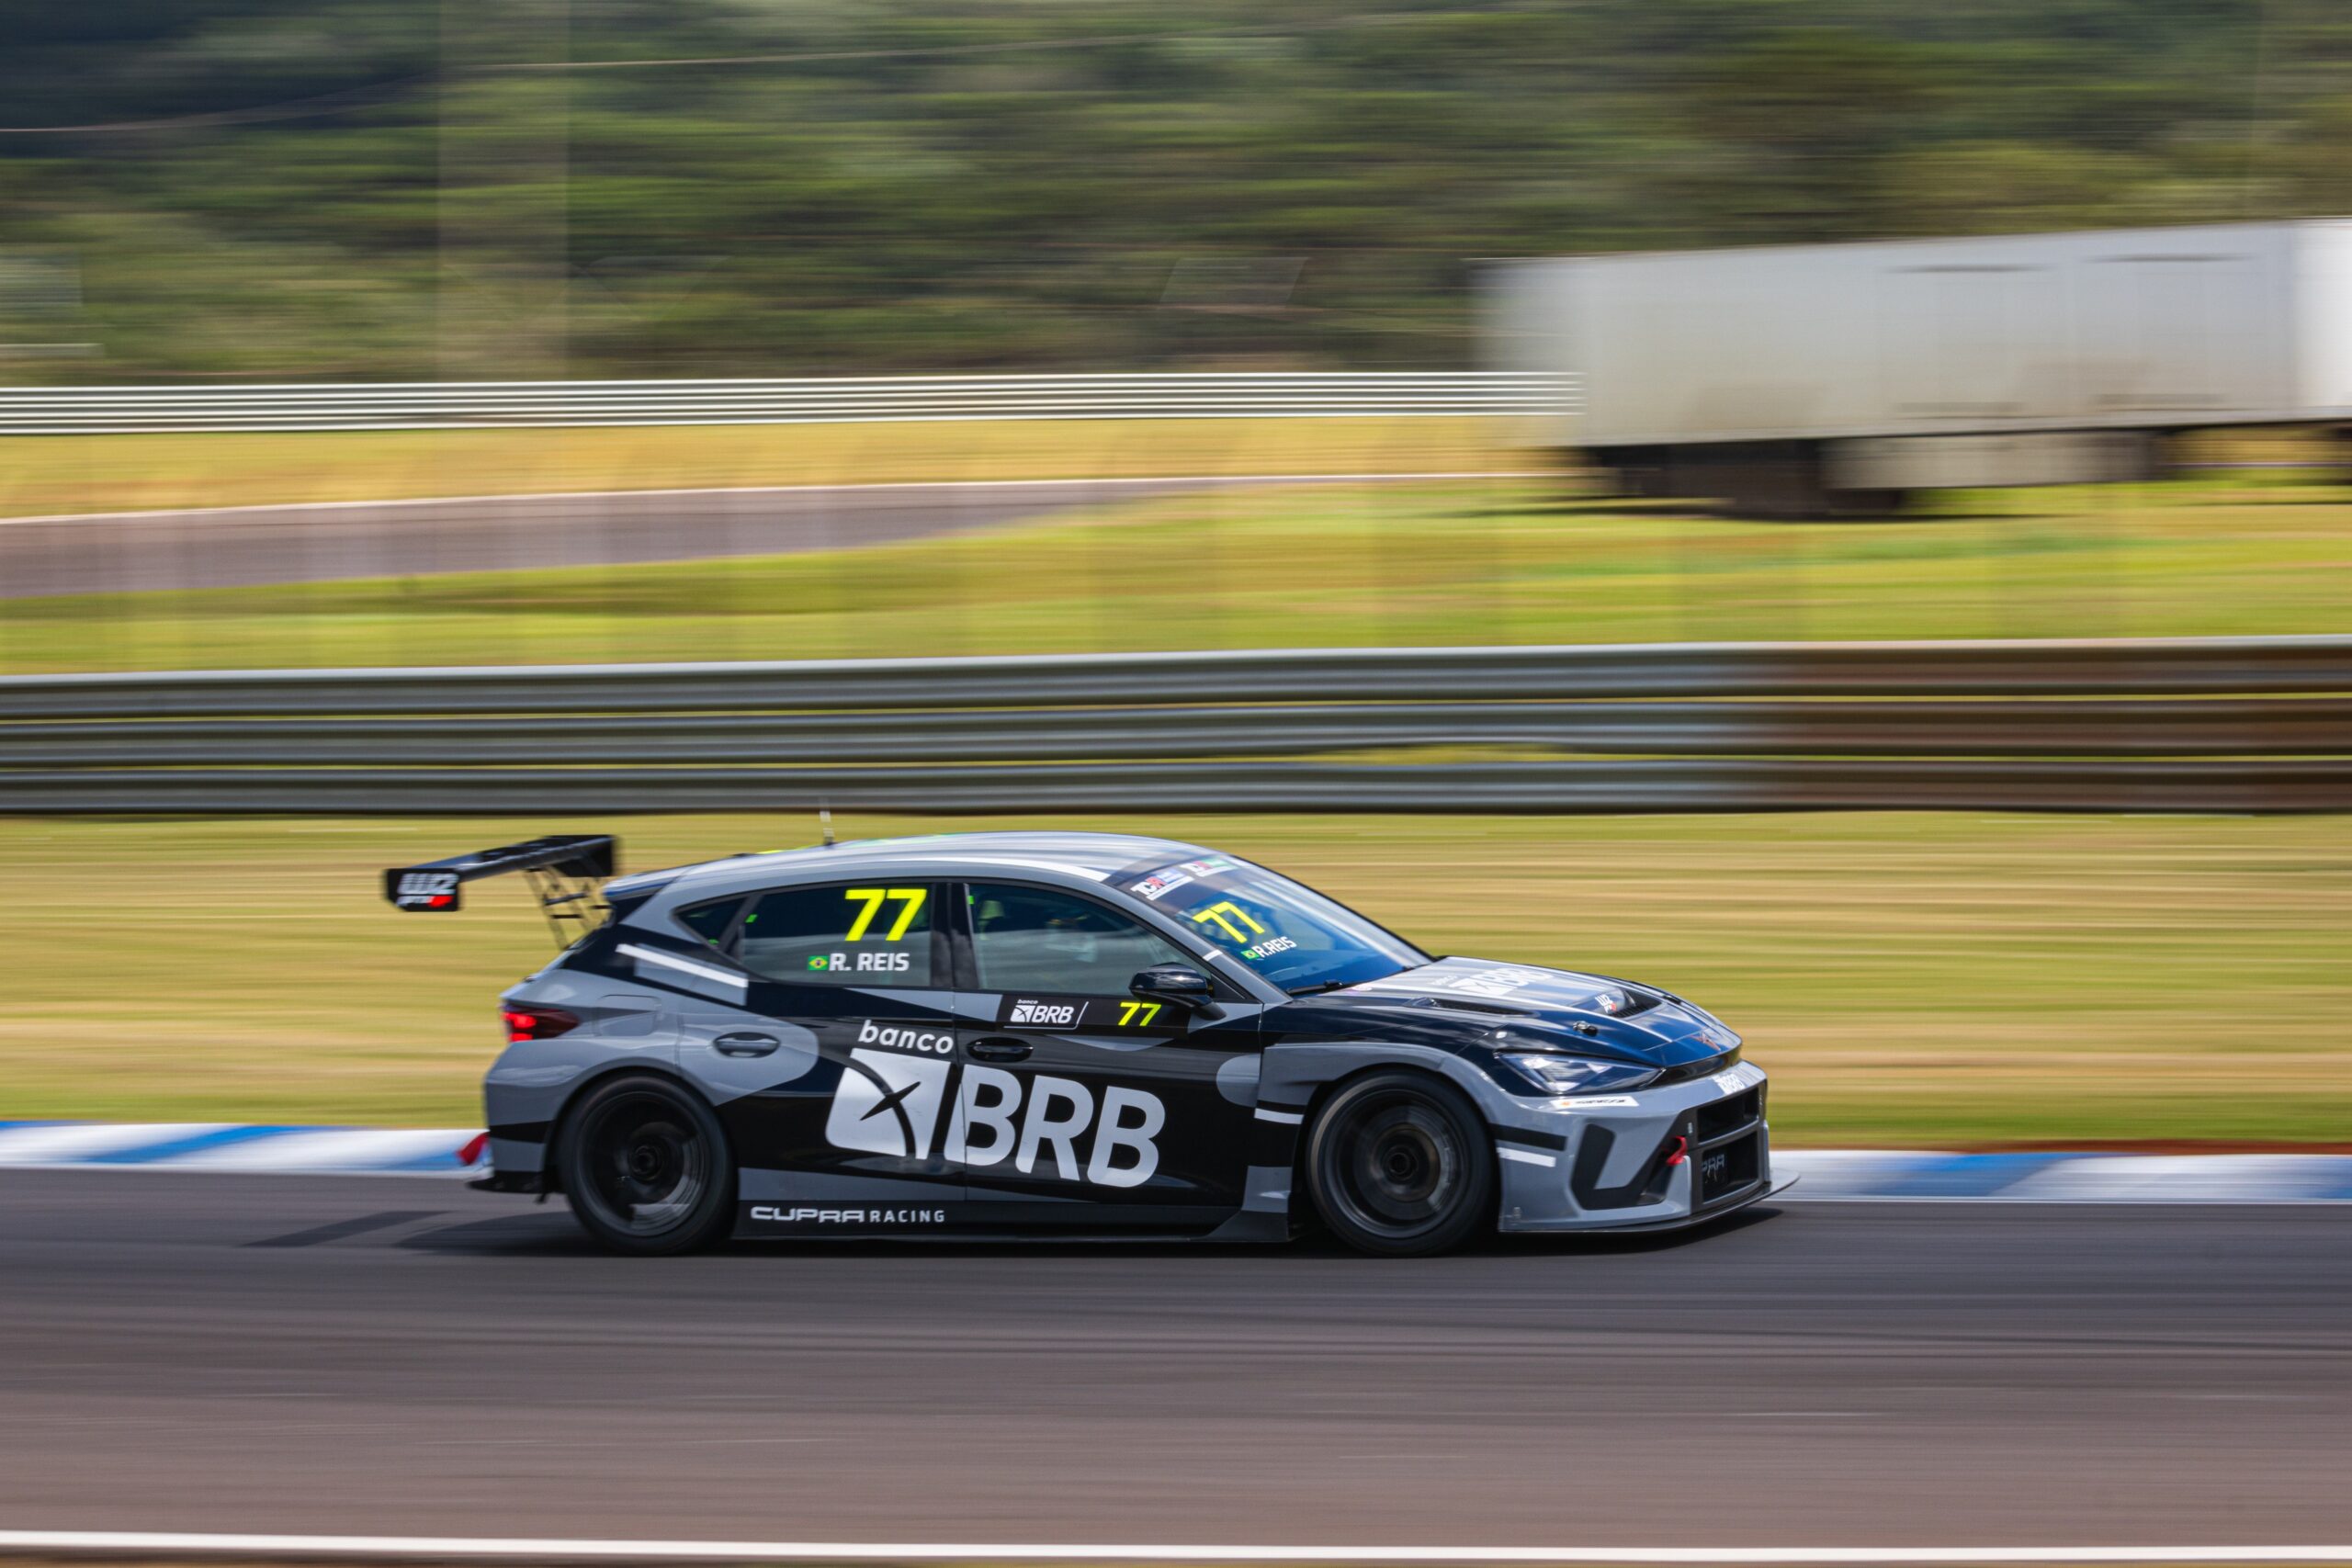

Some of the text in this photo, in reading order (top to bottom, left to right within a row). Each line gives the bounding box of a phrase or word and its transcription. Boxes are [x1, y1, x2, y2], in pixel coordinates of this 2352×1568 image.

[844, 888, 927, 942] 77
[1192, 901, 1265, 944] 77
[829, 953, 910, 972] R. REIS
[1032, 1006, 1075, 1024] BRB
[1117, 1001, 1162, 1027] 77
[857, 1020, 955, 1055] banco
[944, 1064, 1166, 1188] BRB
[750, 1206, 945, 1224] CUPRA RACING
